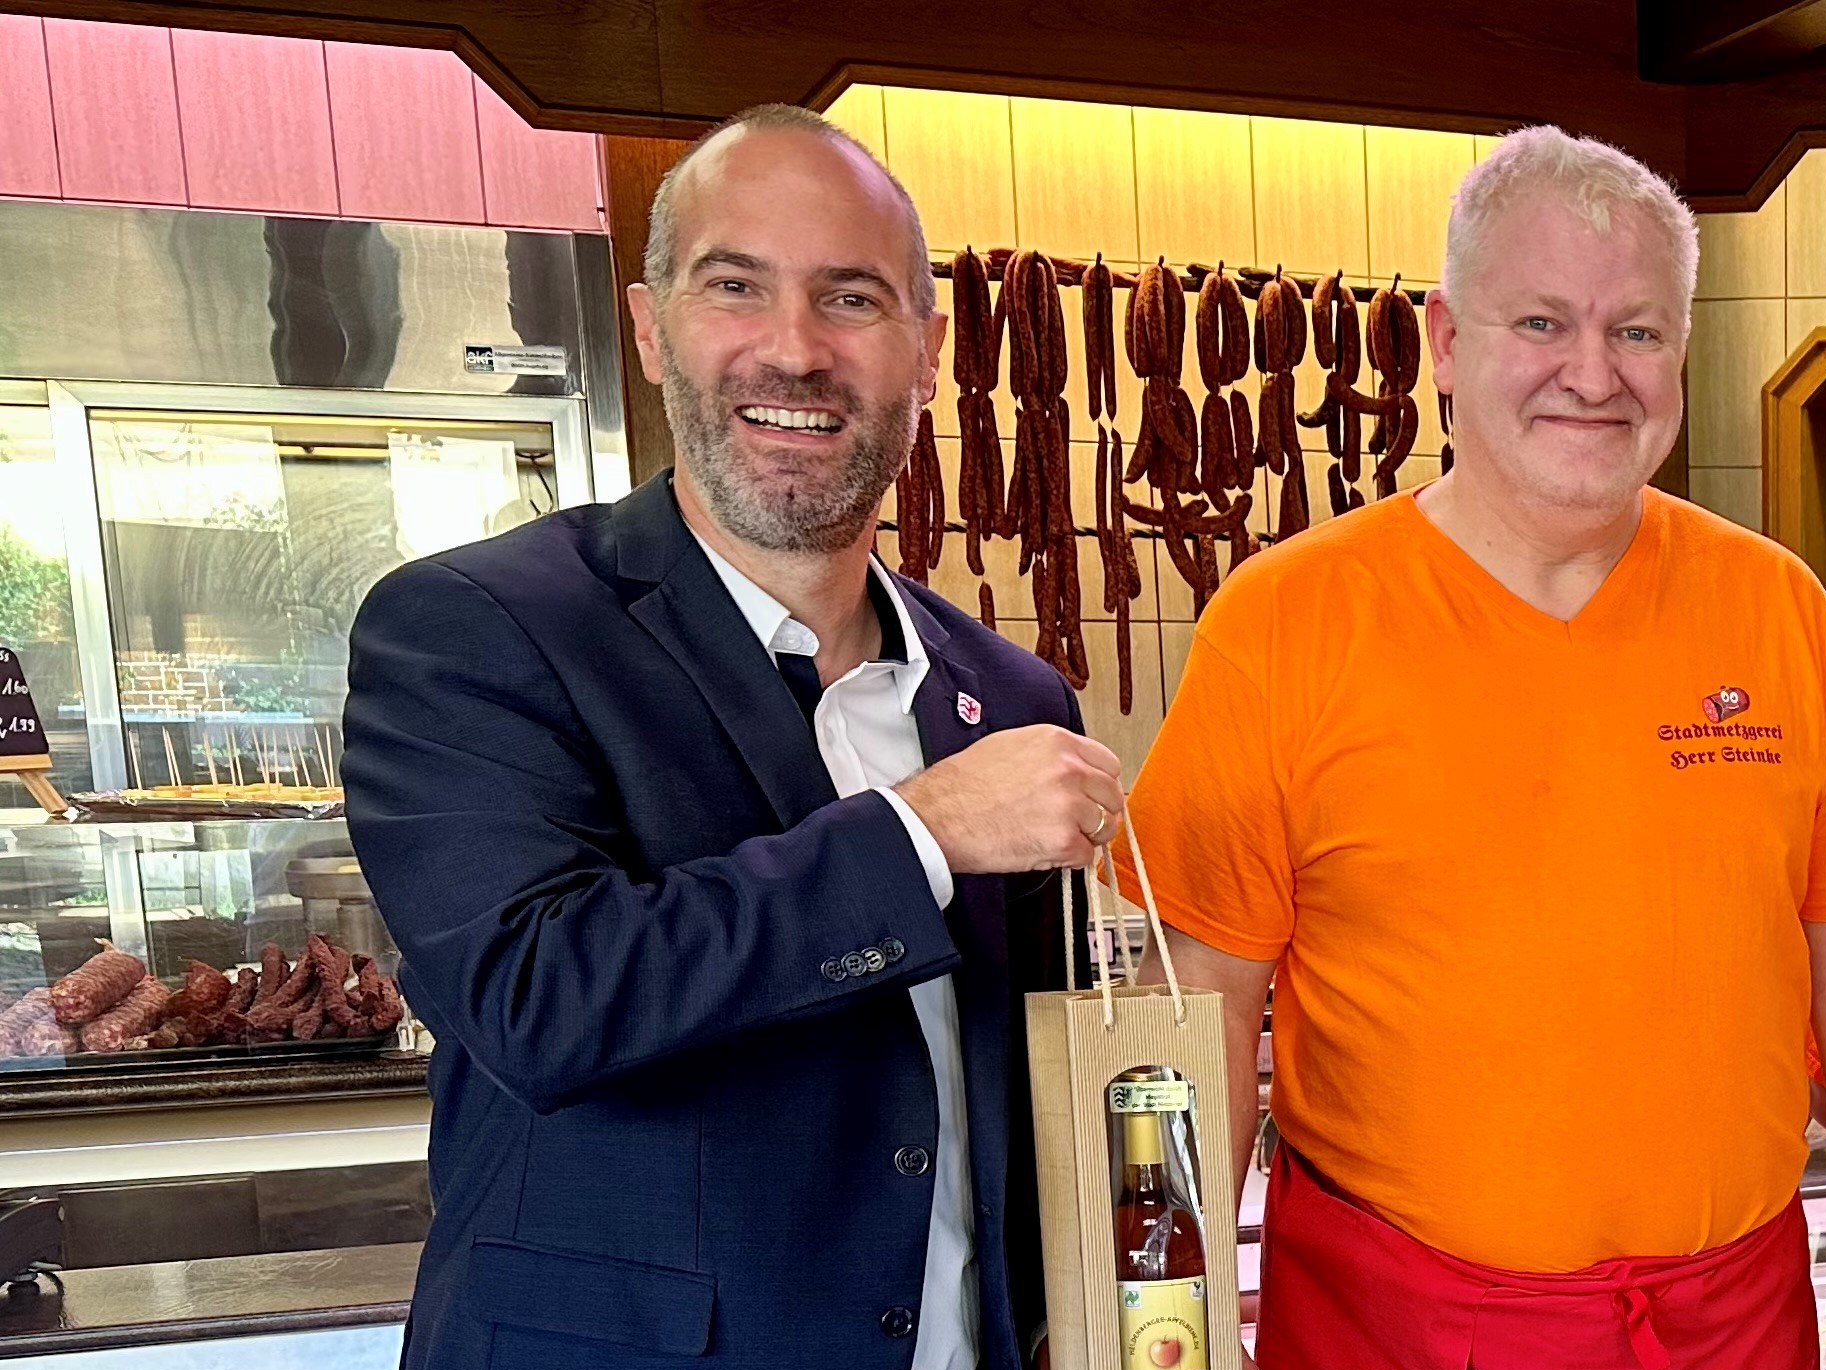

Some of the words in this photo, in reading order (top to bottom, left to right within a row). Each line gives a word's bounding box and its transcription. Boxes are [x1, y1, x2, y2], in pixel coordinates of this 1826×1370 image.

[1657, 722, 1783, 741] Stadtmetzgerei
[1670, 750, 1716, 770] Herr
[1721, 746, 1782, 764] Steinke
